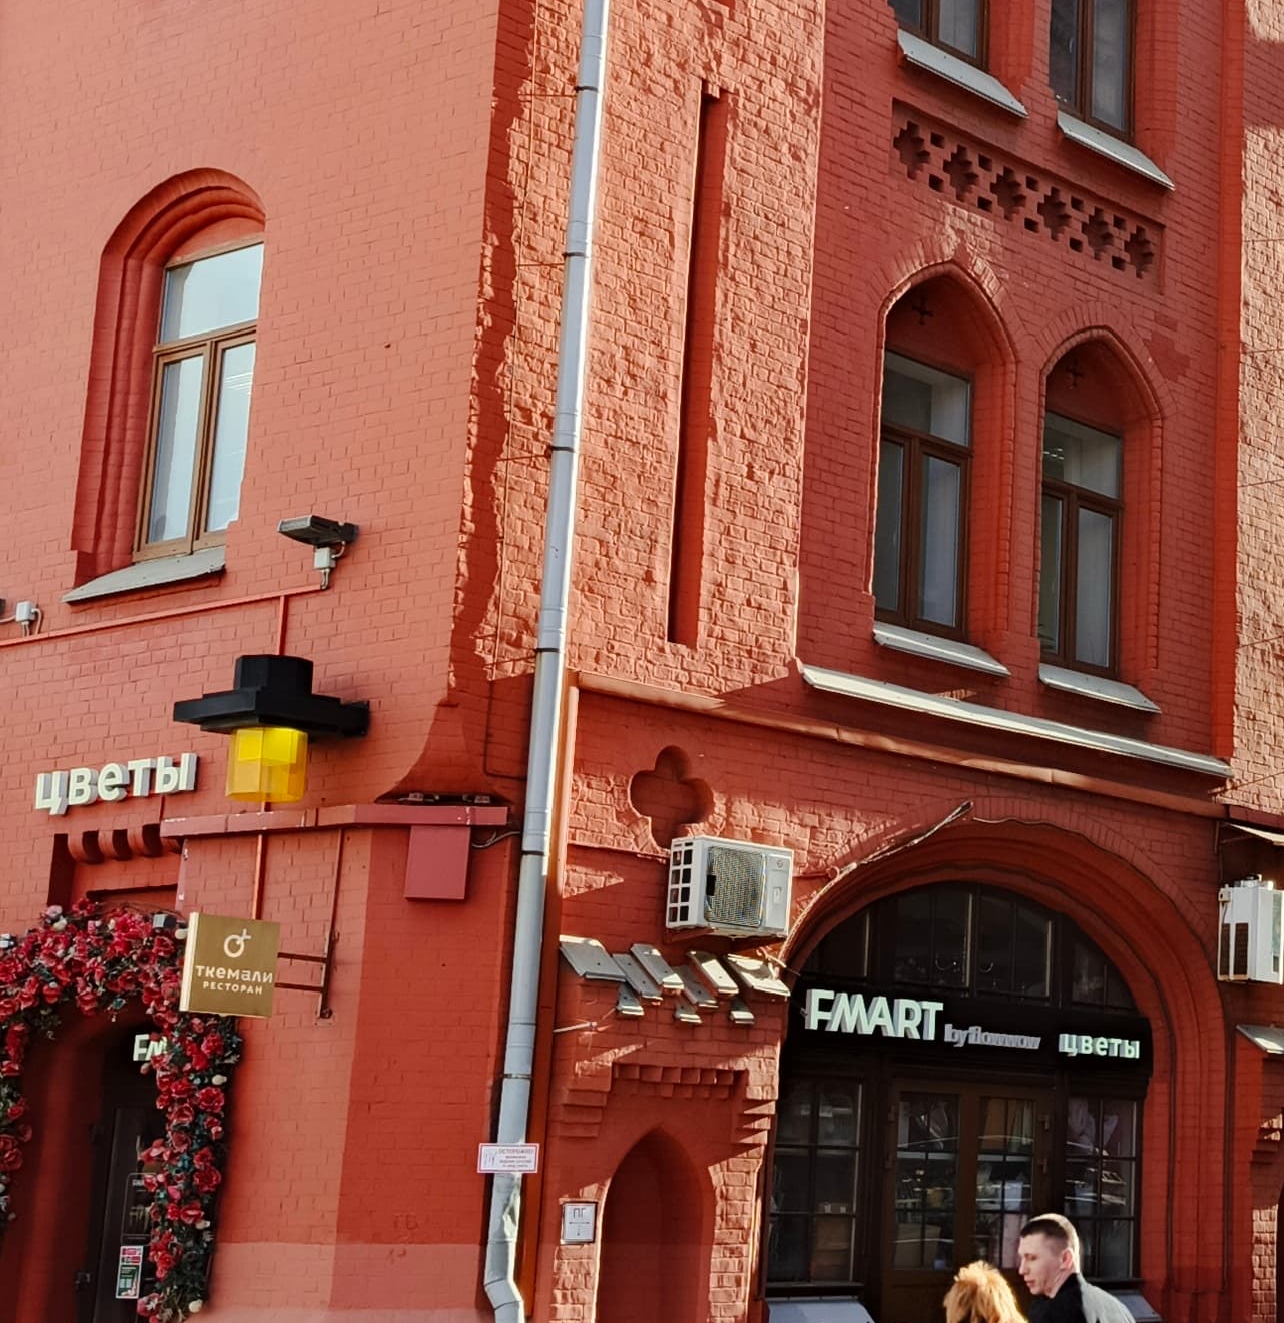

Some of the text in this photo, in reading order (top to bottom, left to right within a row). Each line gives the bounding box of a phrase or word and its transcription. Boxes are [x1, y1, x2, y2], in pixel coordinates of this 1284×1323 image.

[35, 752, 198, 816] цветы
[203, 980, 263, 995] РЕСТОРАН
[804, 988, 945, 1041] FMART
[1058, 1033, 1141, 1059] цветы
